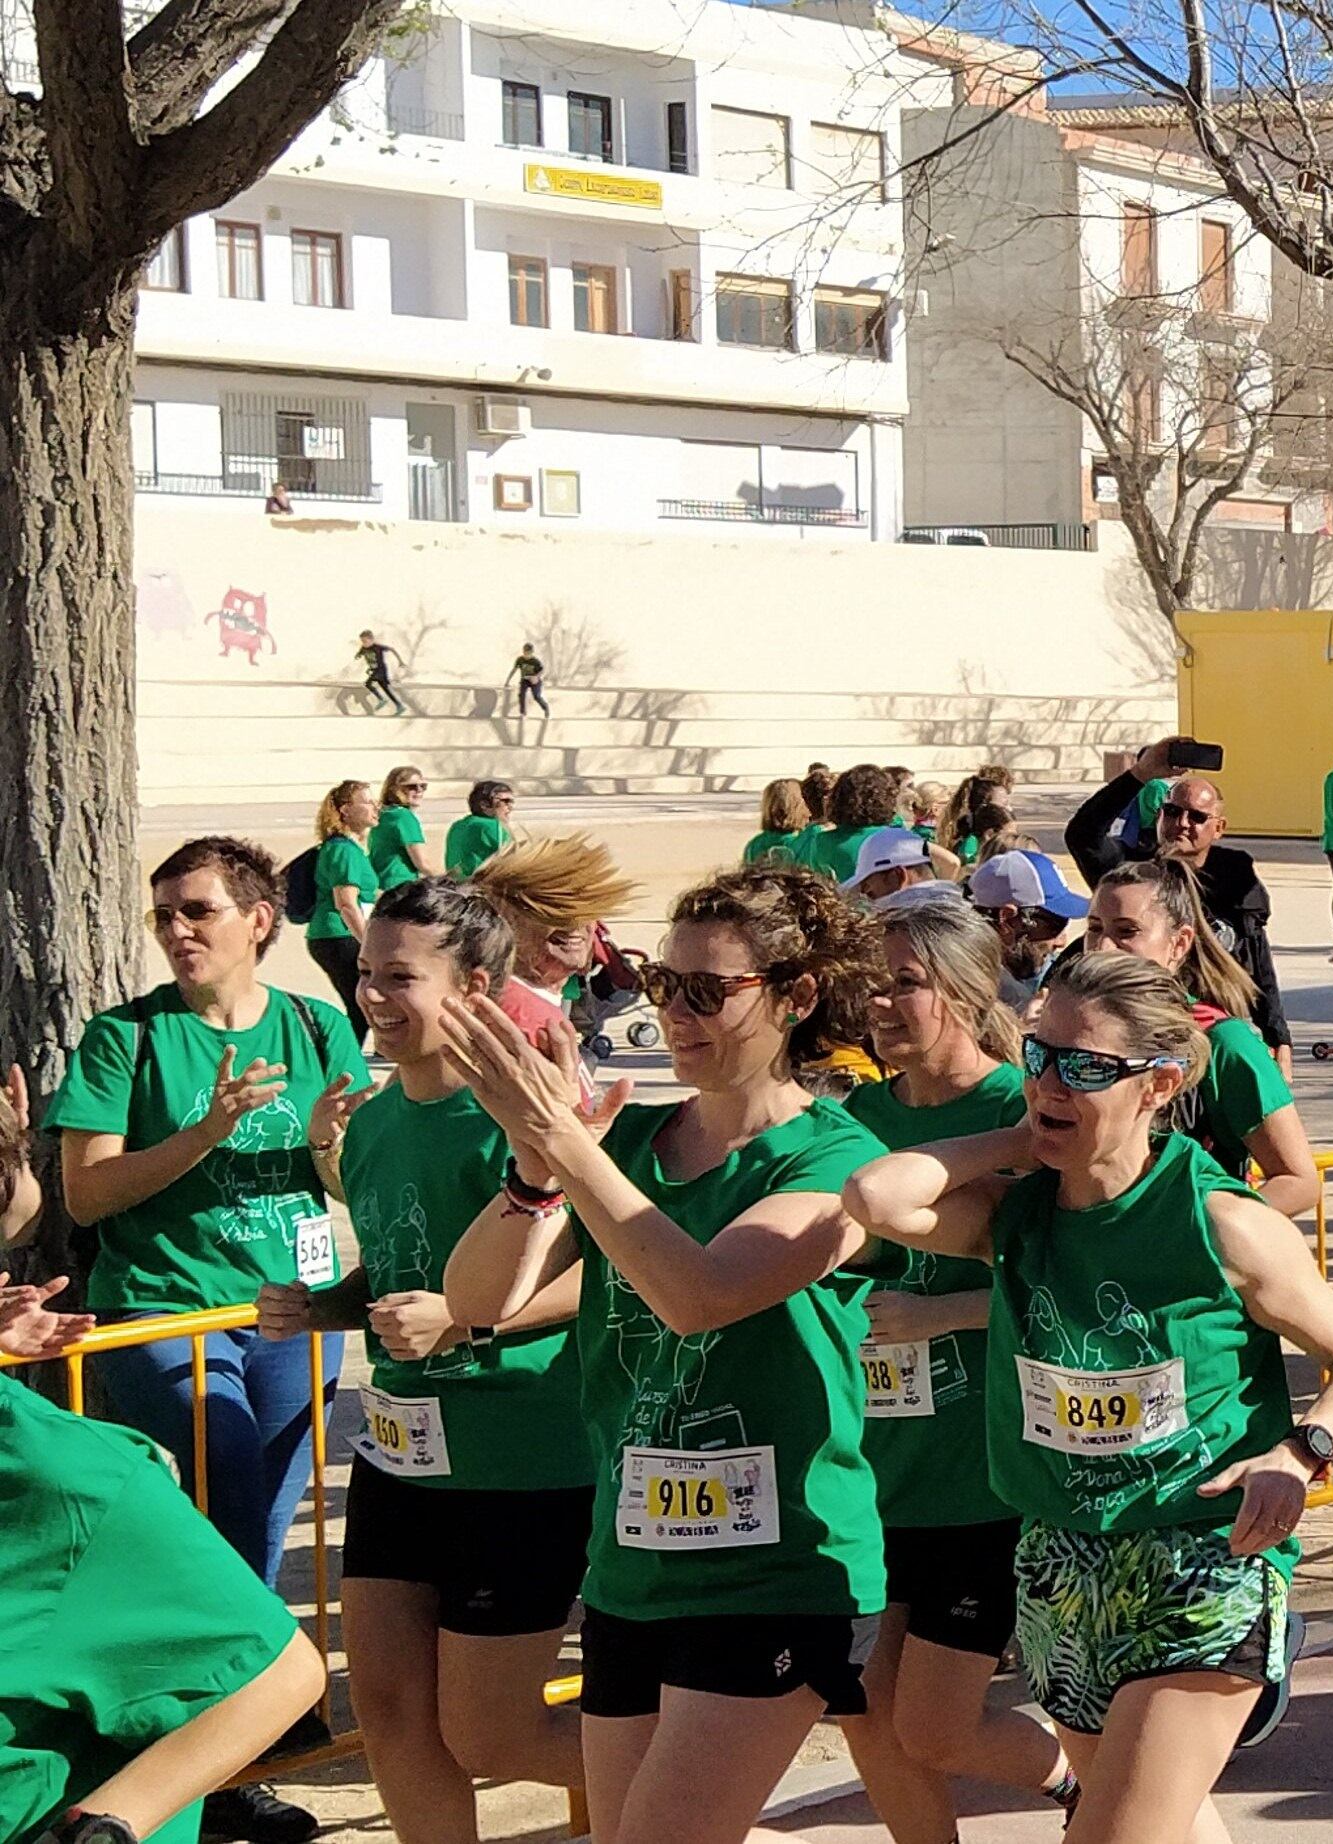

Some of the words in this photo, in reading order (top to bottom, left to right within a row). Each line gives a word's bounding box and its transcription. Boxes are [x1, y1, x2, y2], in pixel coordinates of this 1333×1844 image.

[300, 1235, 330, 1264] 562
[1066, 1395, 1127, 1429] 849
[658, 1479, 714, 1517] 916
